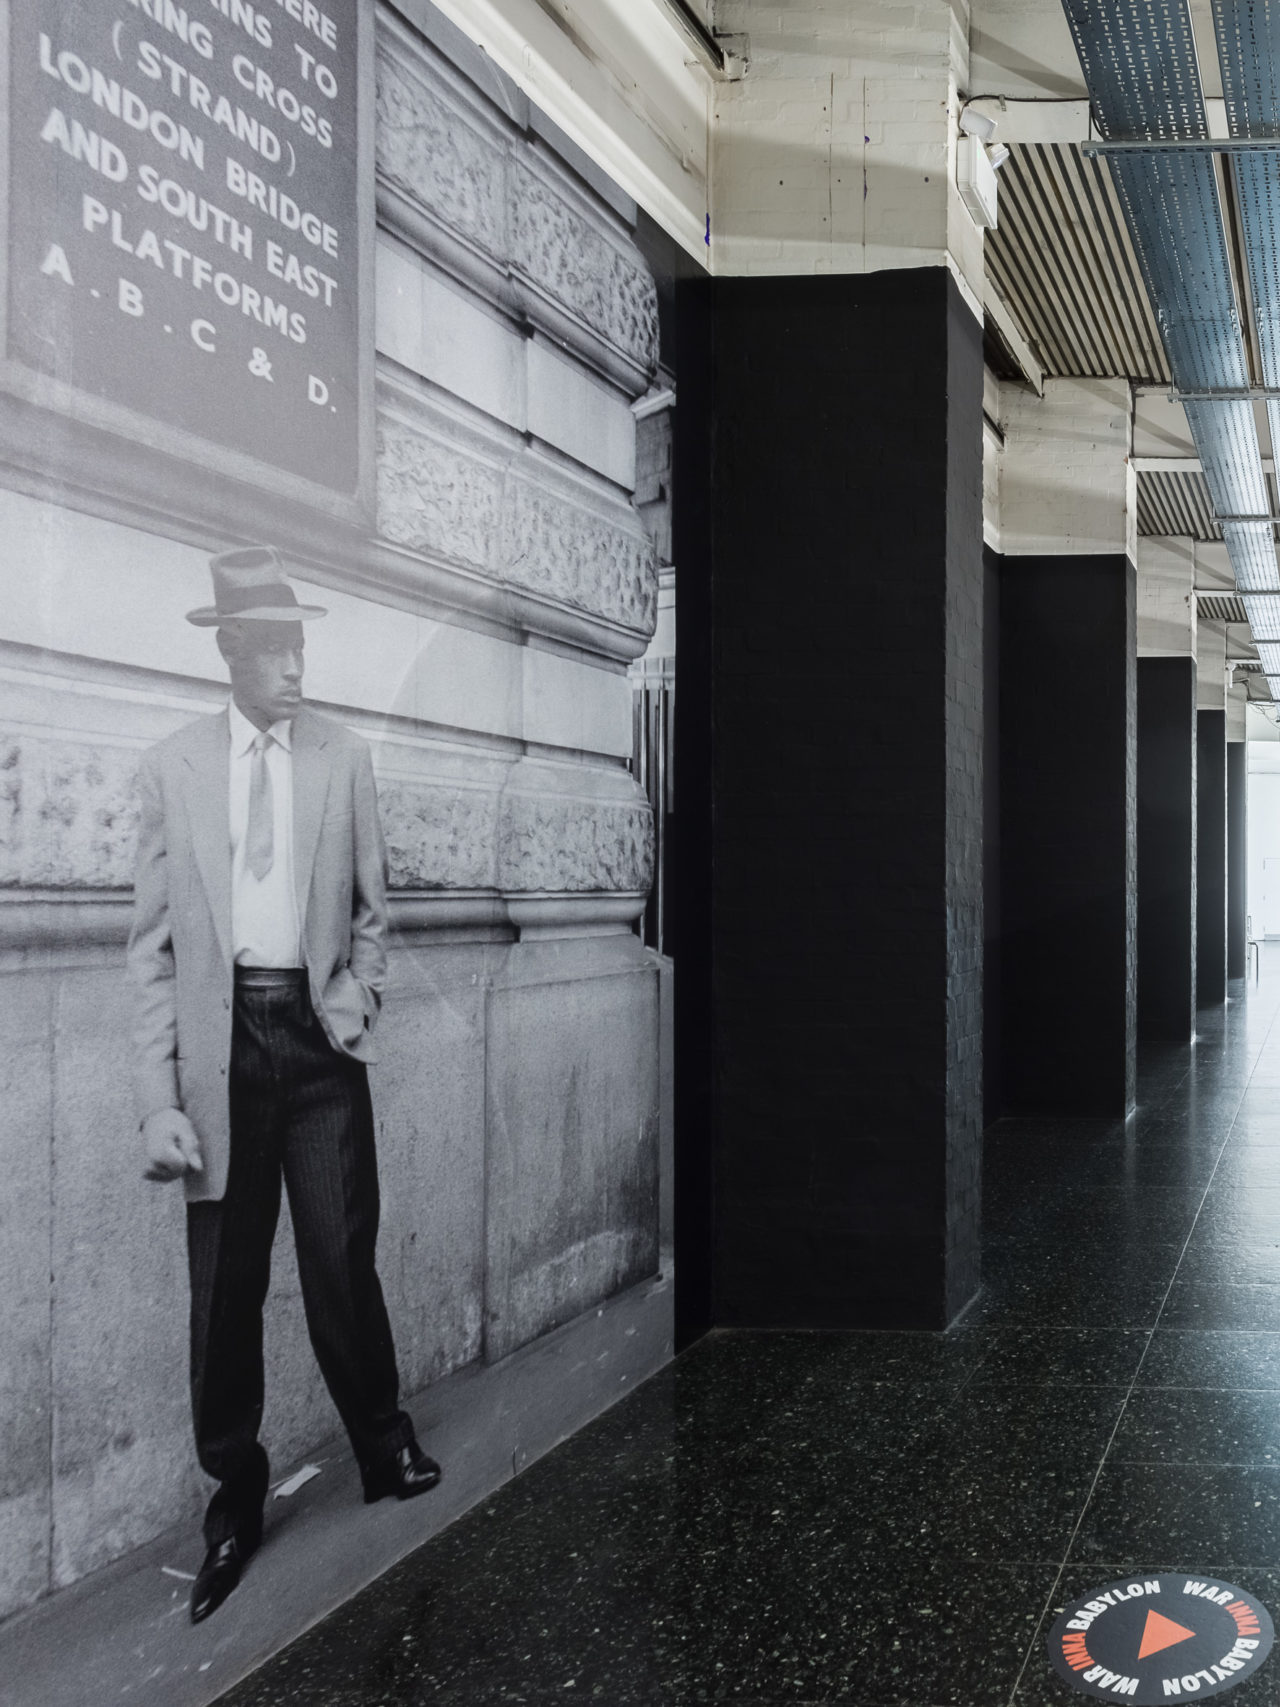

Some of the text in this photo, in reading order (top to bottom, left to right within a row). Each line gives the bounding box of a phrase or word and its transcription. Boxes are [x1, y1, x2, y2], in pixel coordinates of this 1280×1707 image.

[275, 0, 337, 51] ERE
[294, 43, 337, 99] TO
[40, 32, 338, 259] LONDON BRIDGE
[232, 54, 332, 149] CROSS
[41, 107, 337, 308] AND SOUTH EAST
[83, 194, 306, 344] PLATFORMS
[248, 347, 274, 383] &
[1061, 1580, 1161, 1696] WAR INNA BABYLON
[1162, 1580, 1261, 1697] WAR INNA BABYLON
